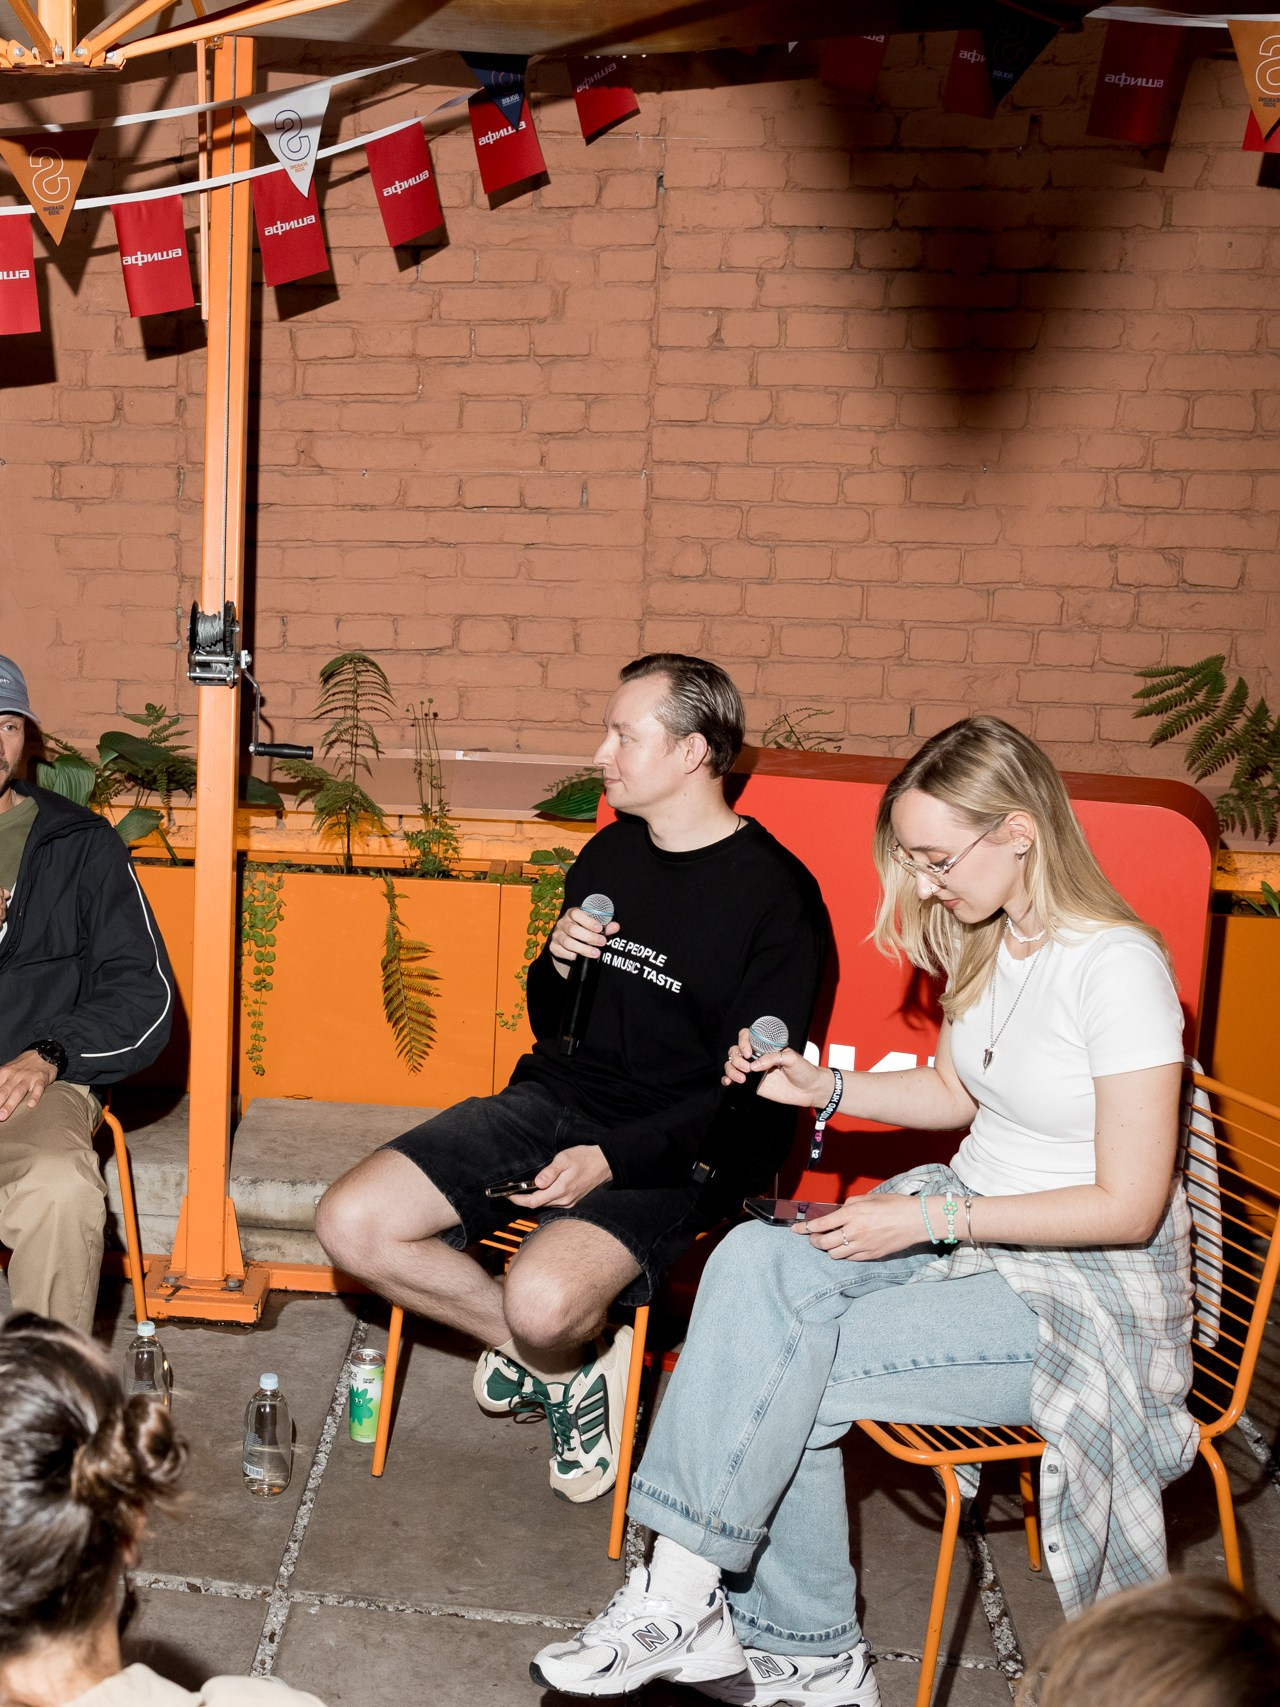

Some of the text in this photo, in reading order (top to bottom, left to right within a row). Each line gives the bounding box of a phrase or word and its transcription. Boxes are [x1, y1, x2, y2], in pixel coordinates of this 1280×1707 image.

[577, 58, 618, 93] афиша
[1105, 73, 1164, 88] афиша
[478, 120, 527, 146] афиша
[382, 169, 430, 197] афиша
[264, 214, 316, 236] афиша
[122, 247, 183, 267] афиша
[625, 941, 668, 967] PEOPLE
[611, 955, 641, 974] MUSIC
[643, 965, 683, 994] TASTE
[632, 1622, 670, 1652] N
[749, 1655, 785, 1679] N
